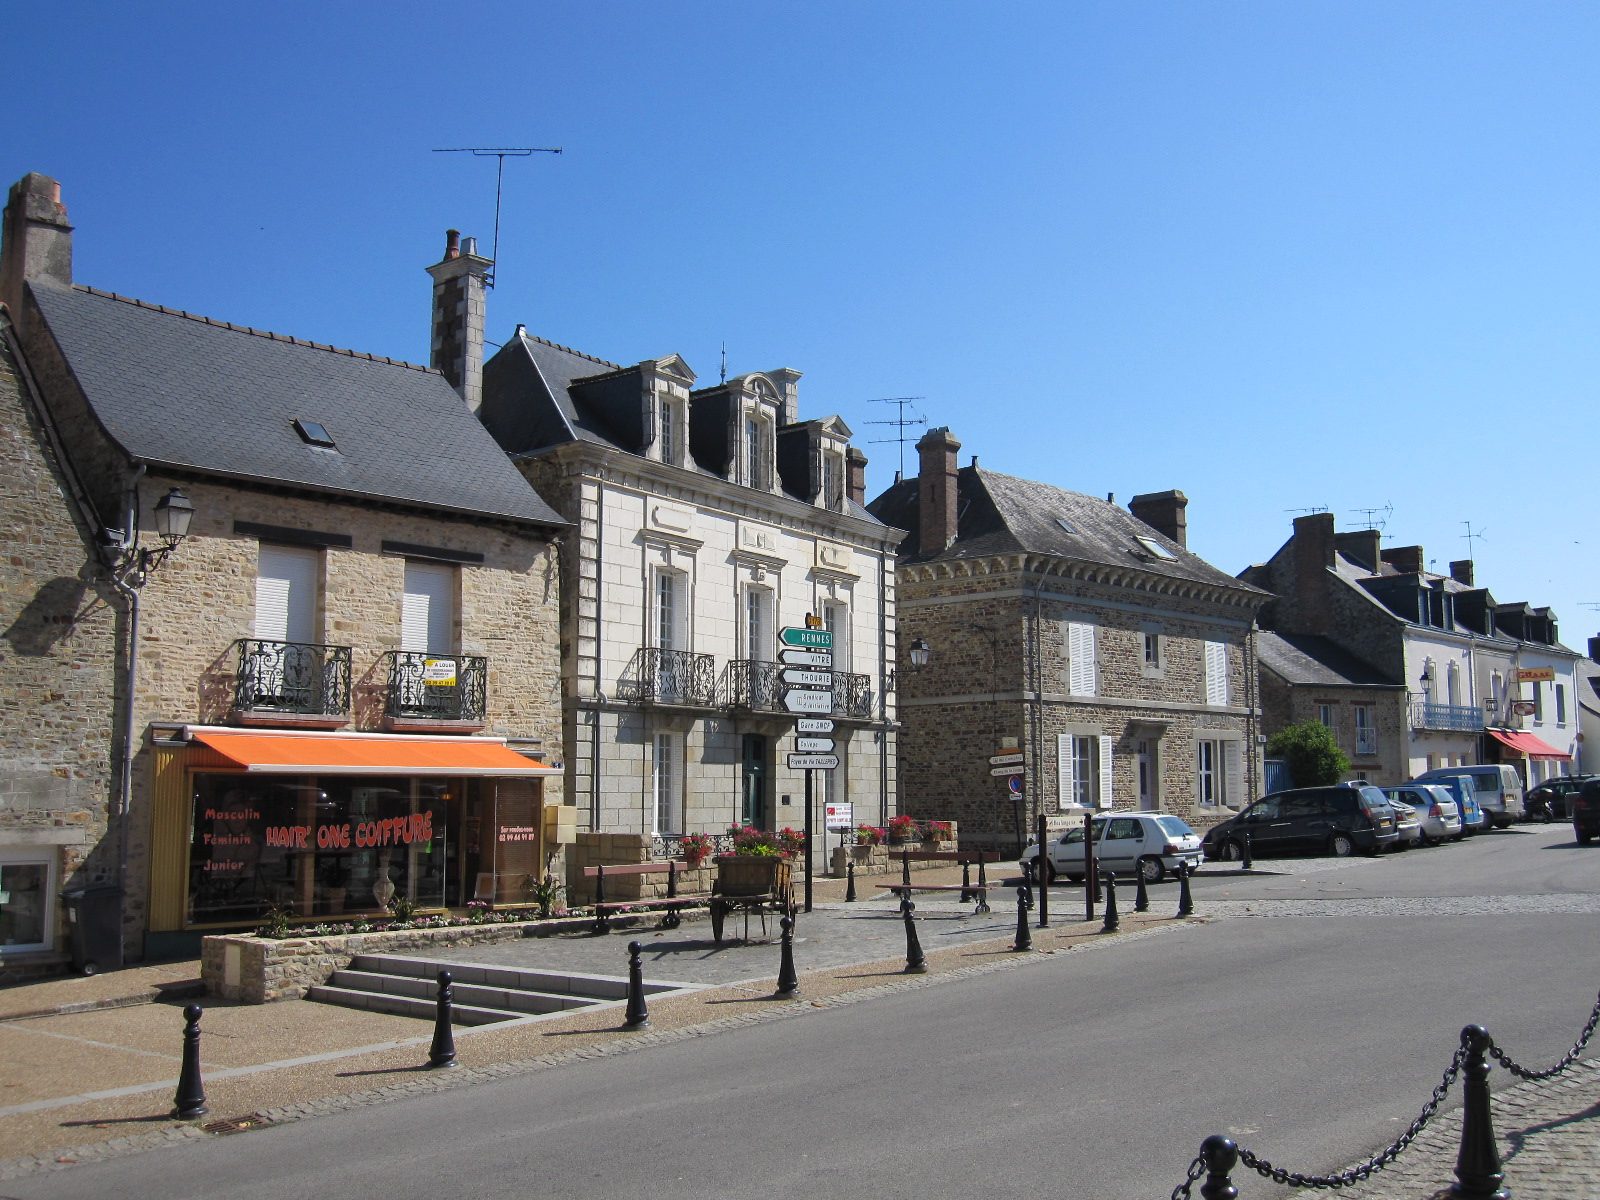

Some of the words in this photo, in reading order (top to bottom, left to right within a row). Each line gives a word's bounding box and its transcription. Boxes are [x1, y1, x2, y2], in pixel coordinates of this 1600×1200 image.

[801, 633, 830, 644] RENNES
[801, 673, 830, 683] THOURIE
[800, 721, 814, 729] Gare
[816, 721, 830, 729] SNCF
[204, 808, 261, 820] Masculin
[317, 823, 351, 849] ONE
[355, 810, 433, 848] COIFFURE
[203, 832, 251, 845] Féminin
[203, 858, 244, 871] Junior
